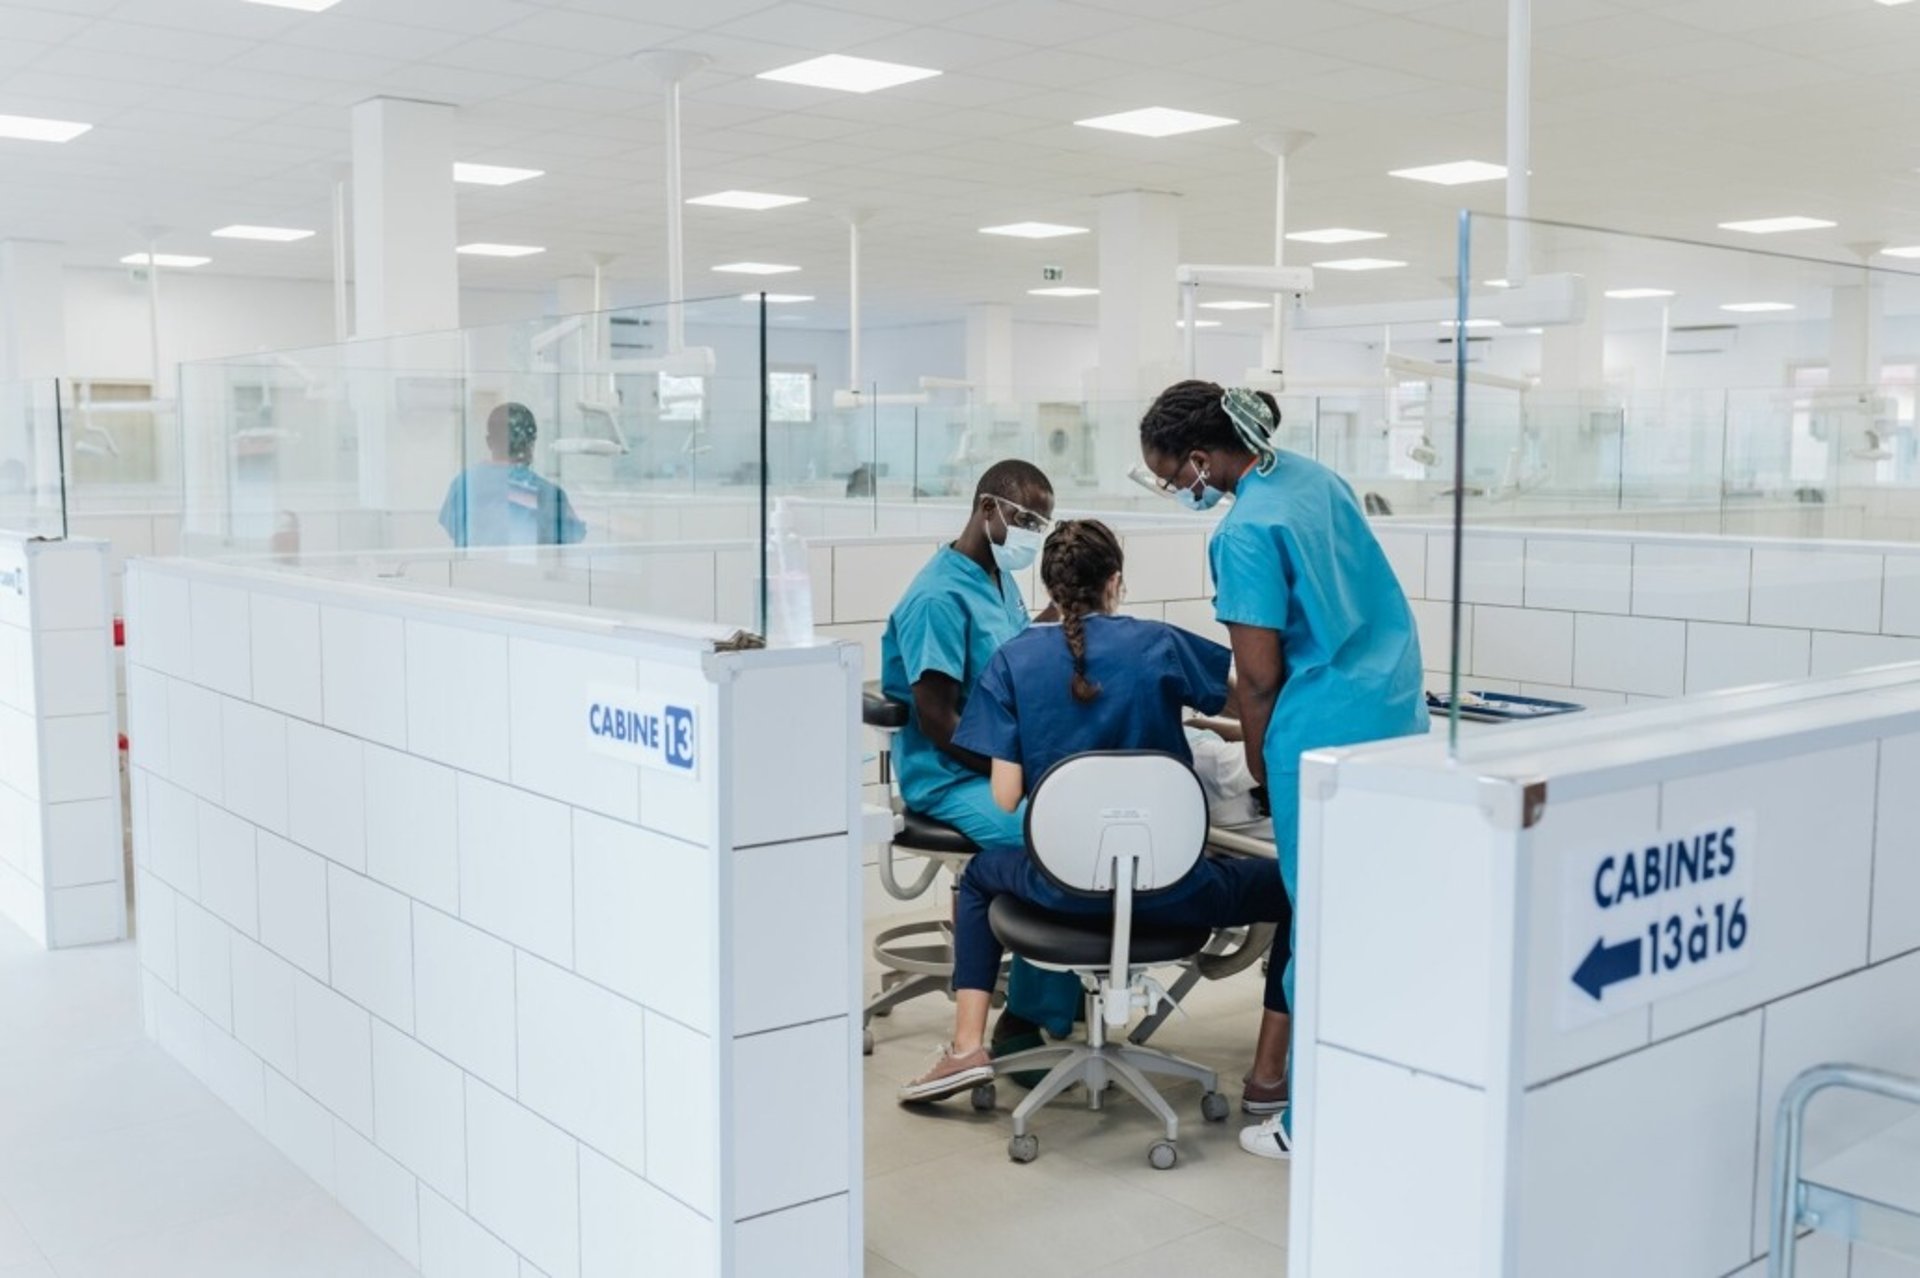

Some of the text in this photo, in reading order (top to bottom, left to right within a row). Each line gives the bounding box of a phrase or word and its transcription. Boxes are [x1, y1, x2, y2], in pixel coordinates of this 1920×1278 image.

[589, 703, 693, 761] CABINE 13
[1594, 827, 1735, 909] CABINES
